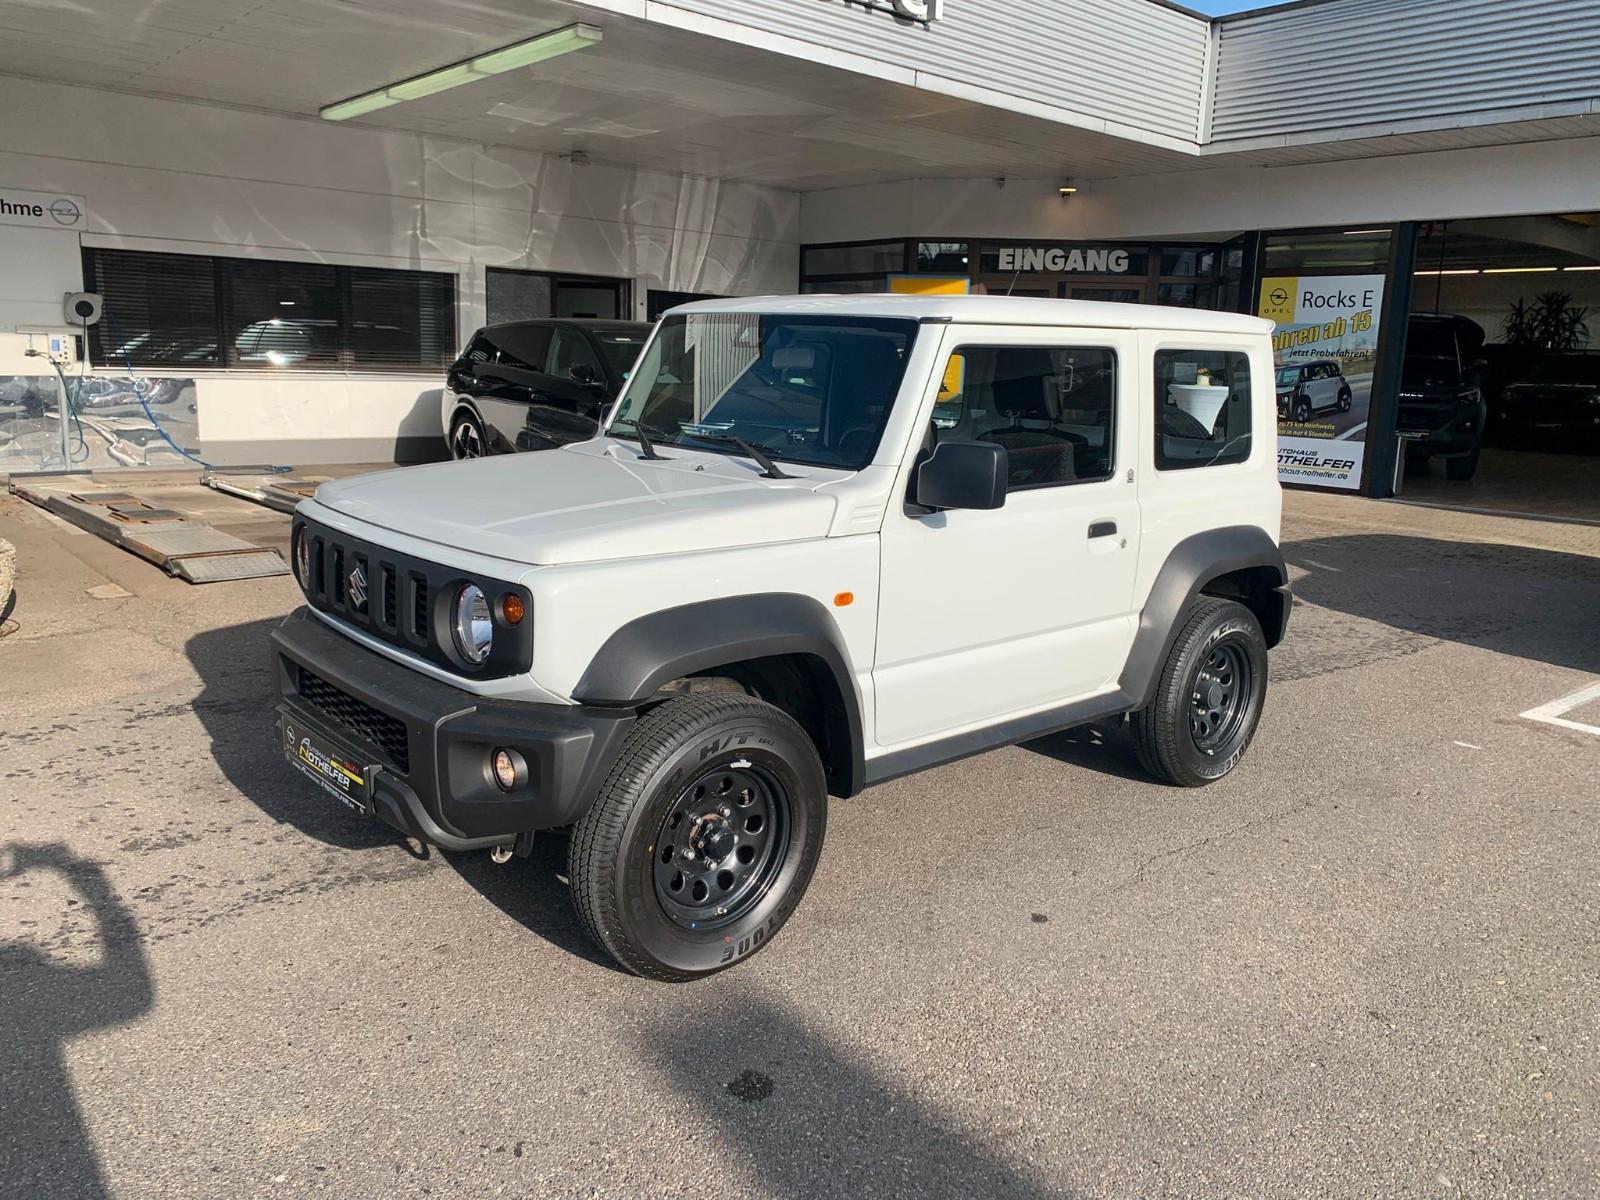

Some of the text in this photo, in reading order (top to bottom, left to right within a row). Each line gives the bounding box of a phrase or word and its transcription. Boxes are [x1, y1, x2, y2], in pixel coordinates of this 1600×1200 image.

[998, 248, 1129, 273] EINGANG
[1302, 290, 1374, 309] Rocks E
[1322, 317, 1348, 341] ab
[1350, 309, 1373, 335] 15
[1288, 348, 1369, 359] jetzt Probefahren!
[300, 745, 350, 788] NOTHELFER
